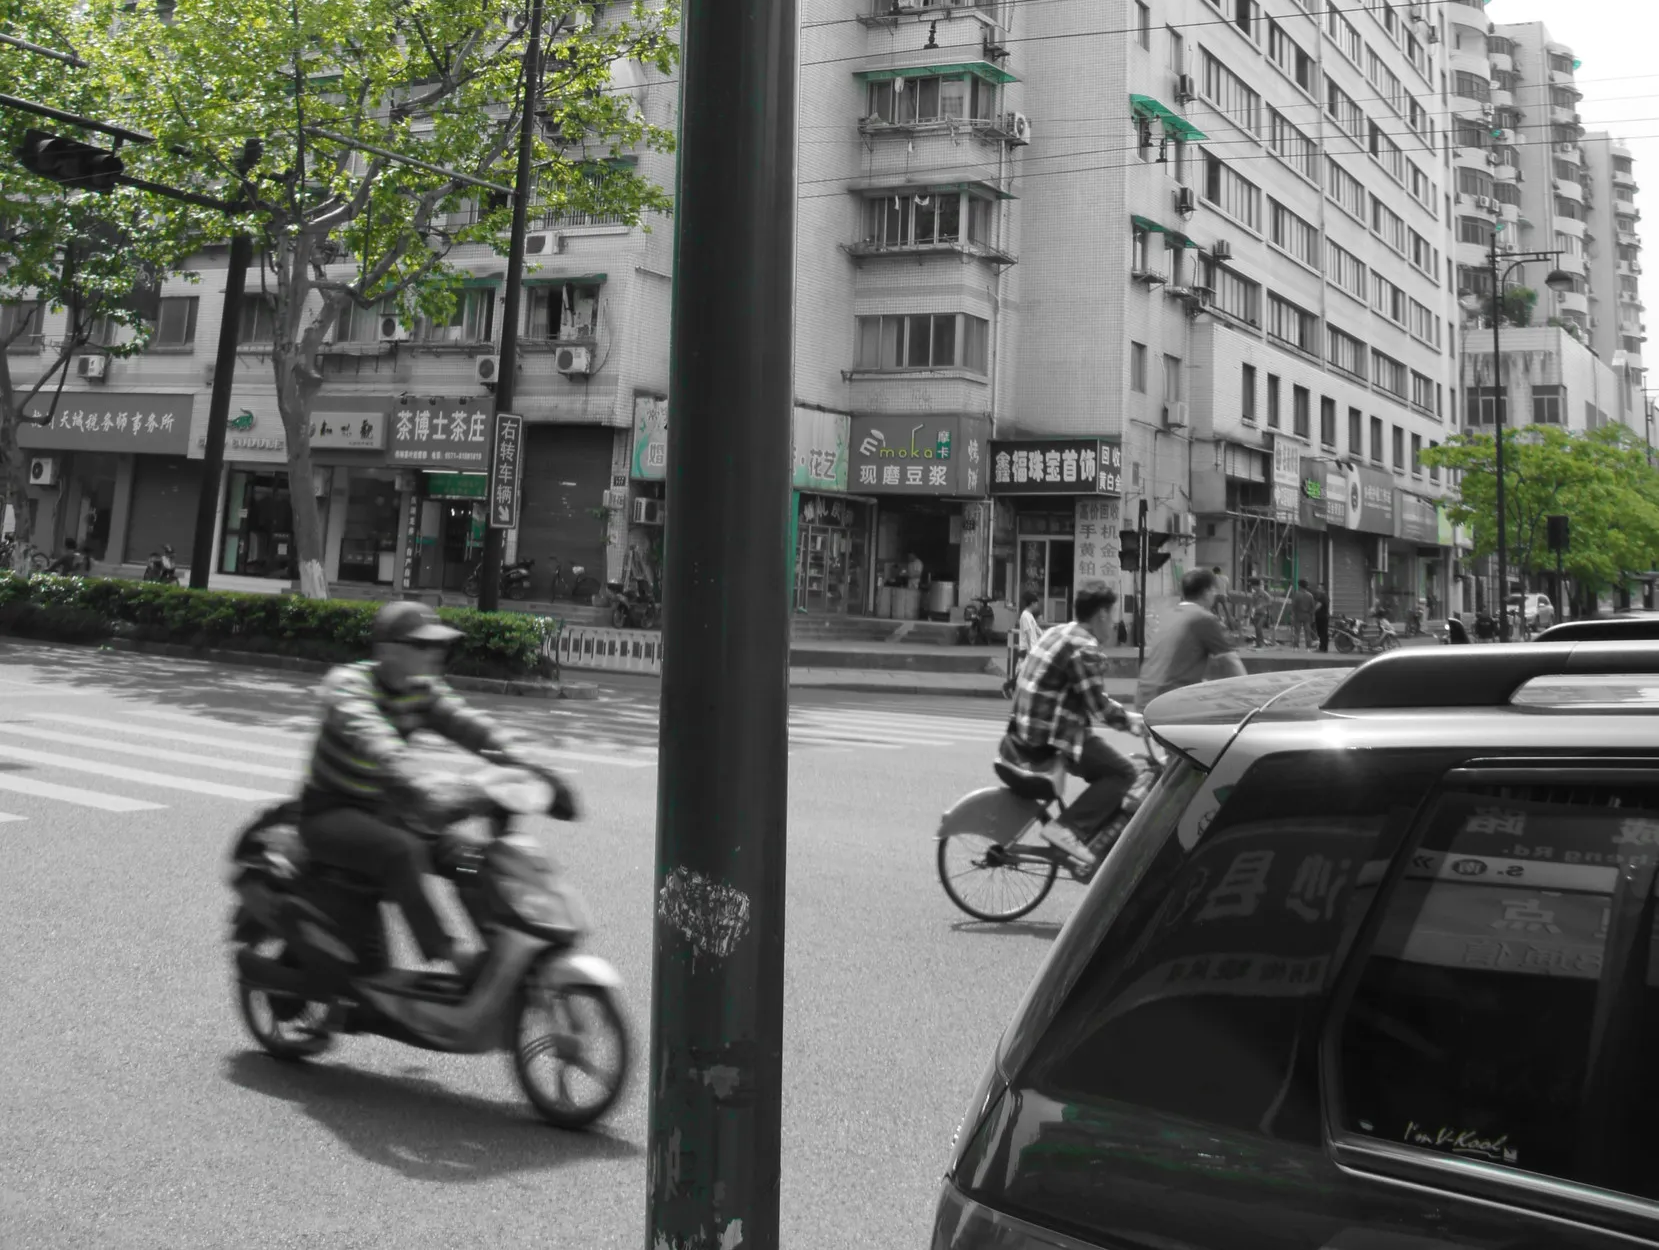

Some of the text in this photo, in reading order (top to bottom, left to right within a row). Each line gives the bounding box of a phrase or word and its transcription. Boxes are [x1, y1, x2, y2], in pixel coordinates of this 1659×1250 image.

[396, 410, 486, 442] 茶博士茶庄
[879, 436, 933, 459] moka
[937, 430, 951, 459] 摩卡
[497, 420, 518, 505] 右转车辆
[995, 449, 1096, 483] 鑫福珠宝首饰
[1101, 445, 1121, 467] 回收
[859, 465, 948, 486] 现磨豆浆
[1099, 470, 1122, 492] 黄白金
[1079, 503, 1120, 521] 高价回收
[1079, 524, 1118, 540] 手机
[1079, 542, 1118, 558] 黄金
[1078, 561, 1118, 577] 铂金
